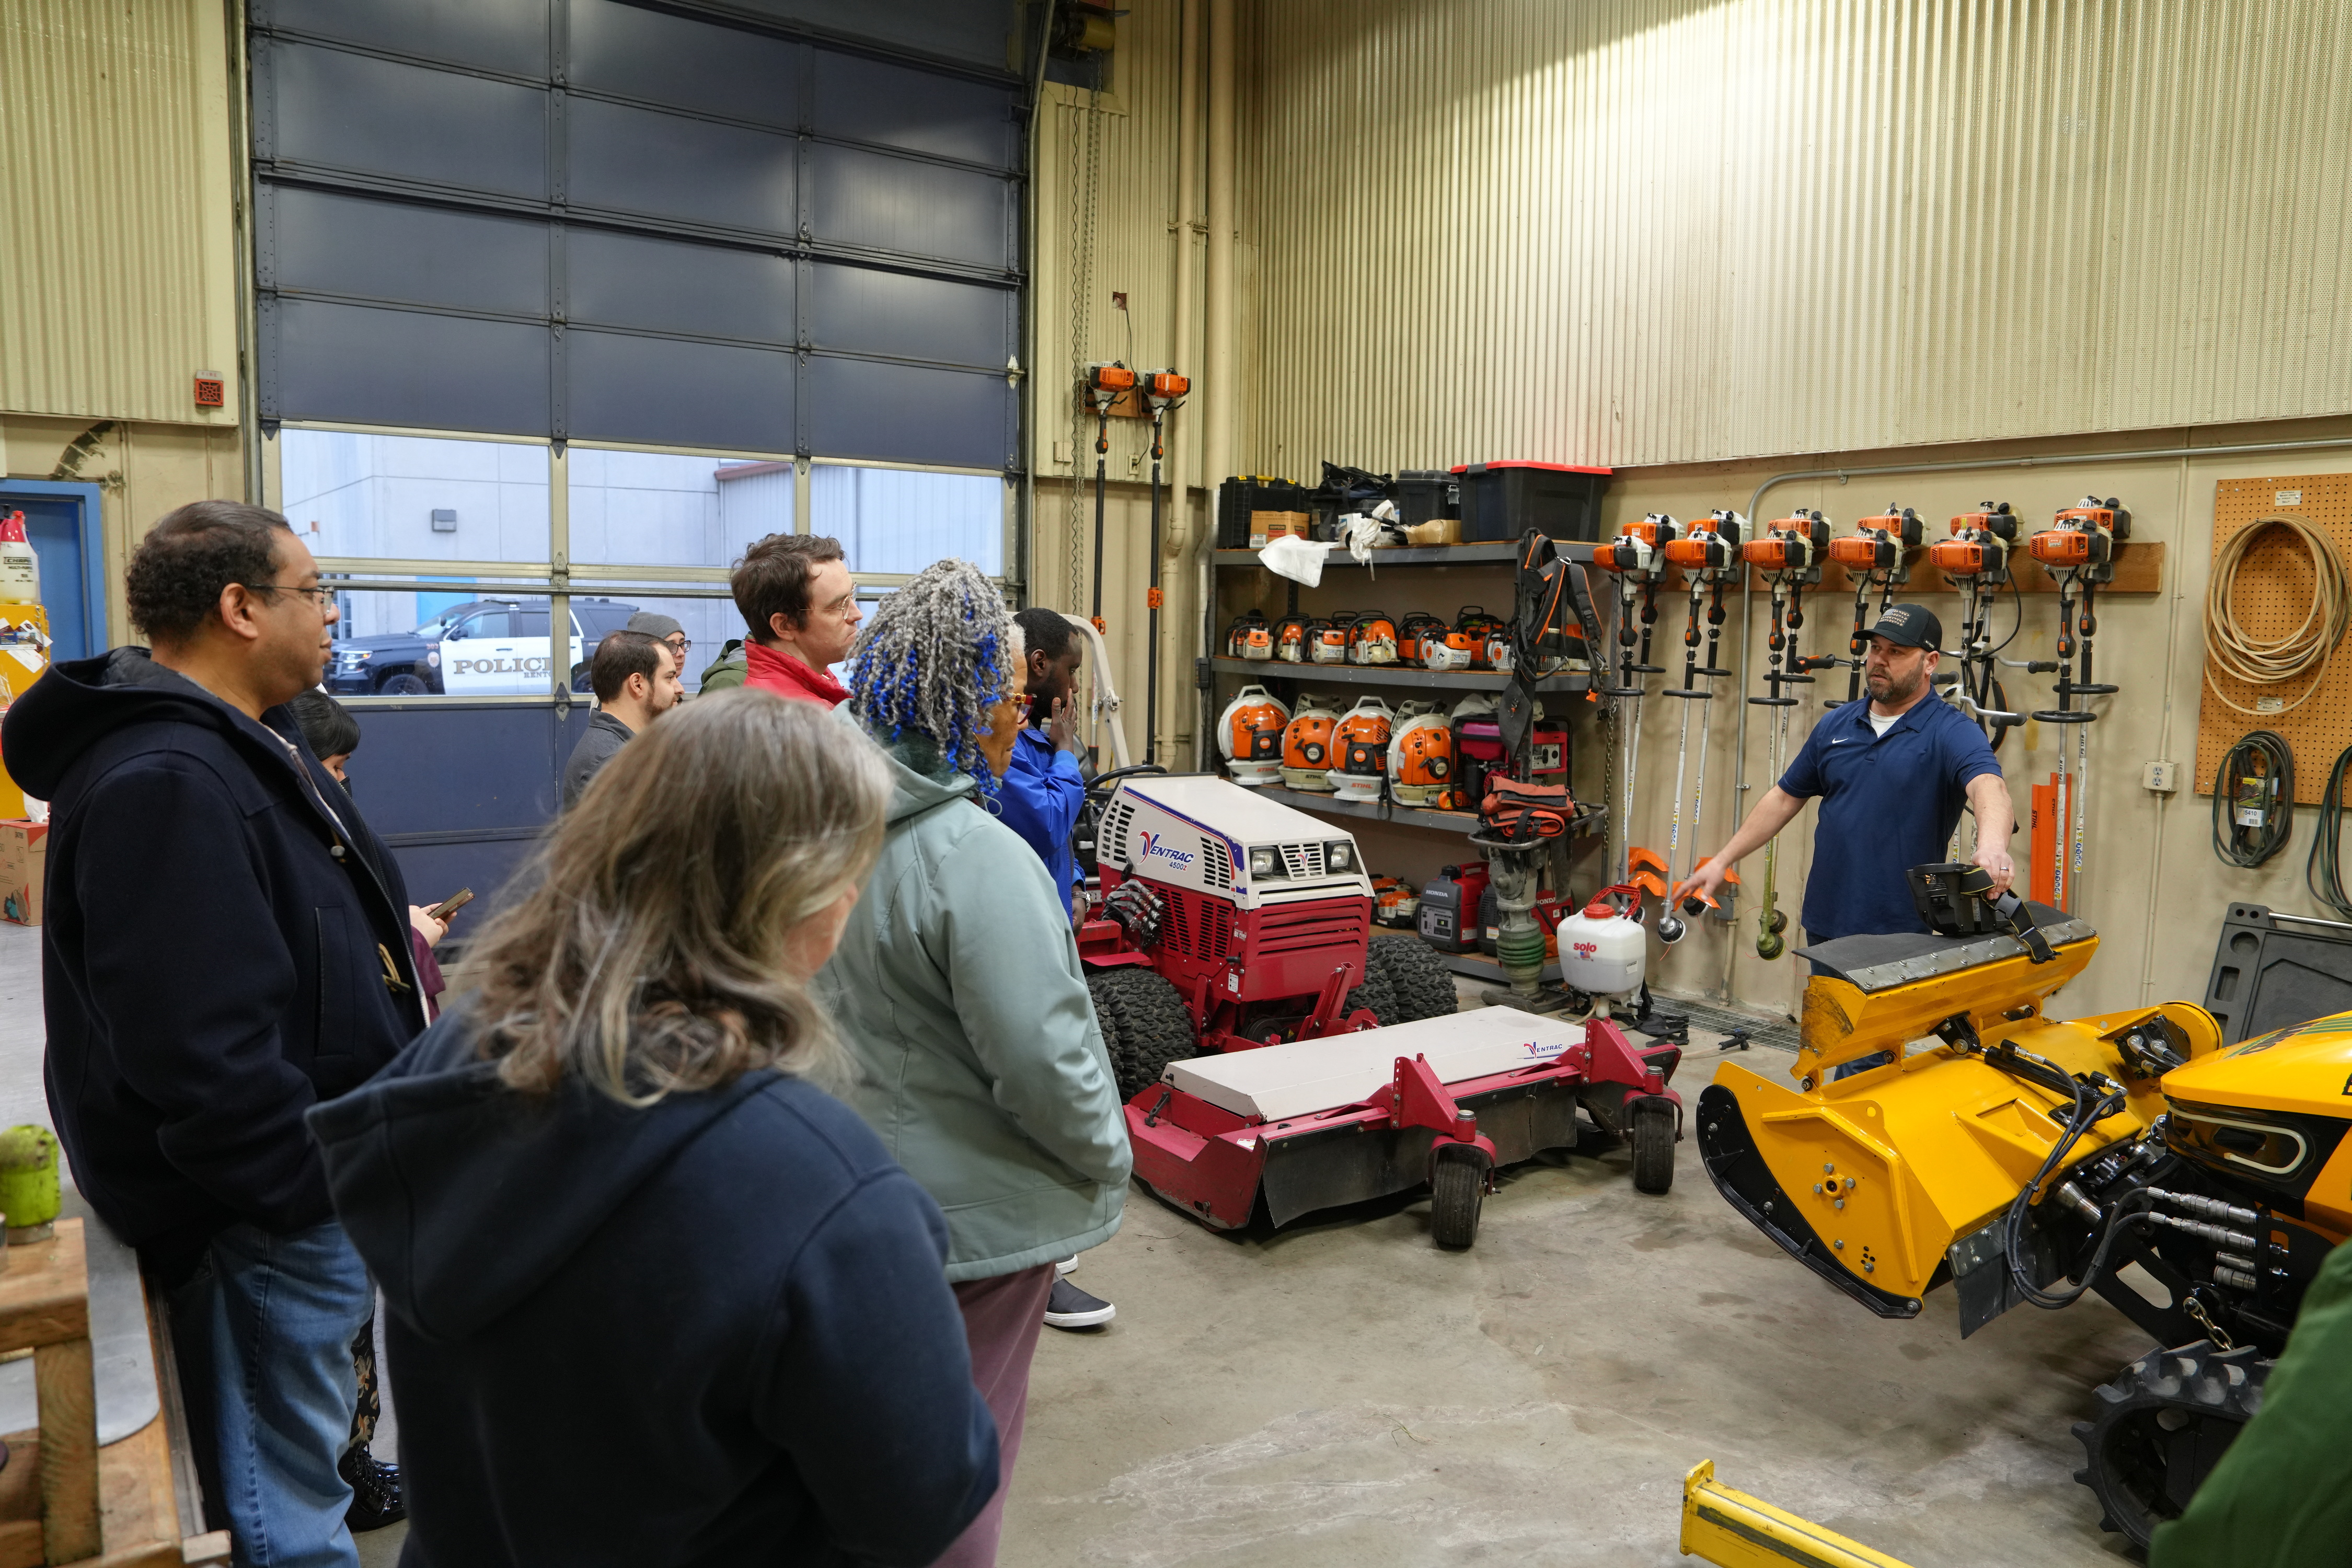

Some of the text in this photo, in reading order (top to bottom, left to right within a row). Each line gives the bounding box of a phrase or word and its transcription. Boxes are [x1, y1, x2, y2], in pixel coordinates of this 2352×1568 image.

[1138, 831, 1194, 864] VENTRAC
[1573, 942, 1597, 952] solo
[1524, 1041, 1563, 1059] VENTRAC
